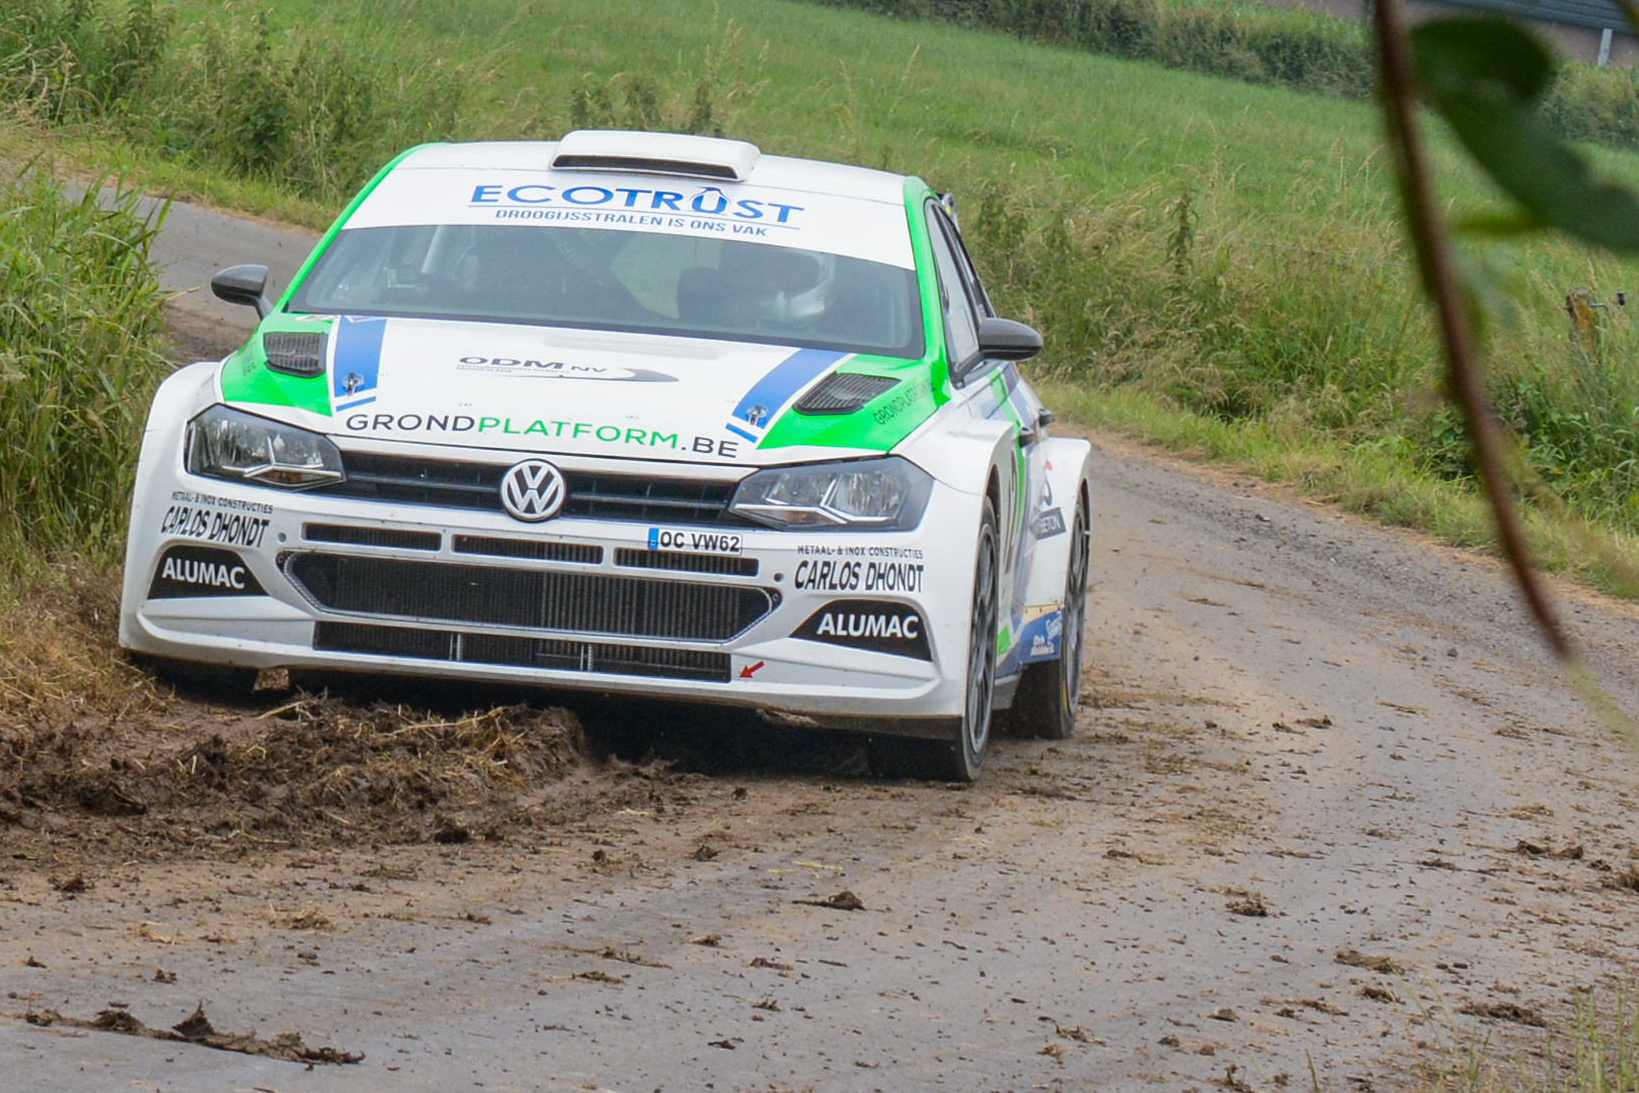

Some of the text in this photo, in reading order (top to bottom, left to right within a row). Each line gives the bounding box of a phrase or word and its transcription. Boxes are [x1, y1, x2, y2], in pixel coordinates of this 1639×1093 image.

[471, 185, 805, 223] ECOTRUST
[495, 208, 767, 237] DROOGIJSSTRALEN IS ONS VAK
[459, 356, 565, 370] ODM
[345, 414, 740, 459] GRONDPLATFORM.BE
[218, 497, 273, 514] CONSTRUCTIES
[161, 505, 270, 547] CARLOS DHONDT
[661, 530, 685, 549] OC
[691, 533, 740, 553] VW62
[797, 545, 835, 555] METAAL-
[845, 547, 866, 557] INOX
[868, 547, 923, 559] CONSTRUCTIES
[162, 557, 245, 589] ALUMAC
[794, 559, 924, 593] CARLOS DHONDT
[816, 613, 919, 639] ALUMAC
